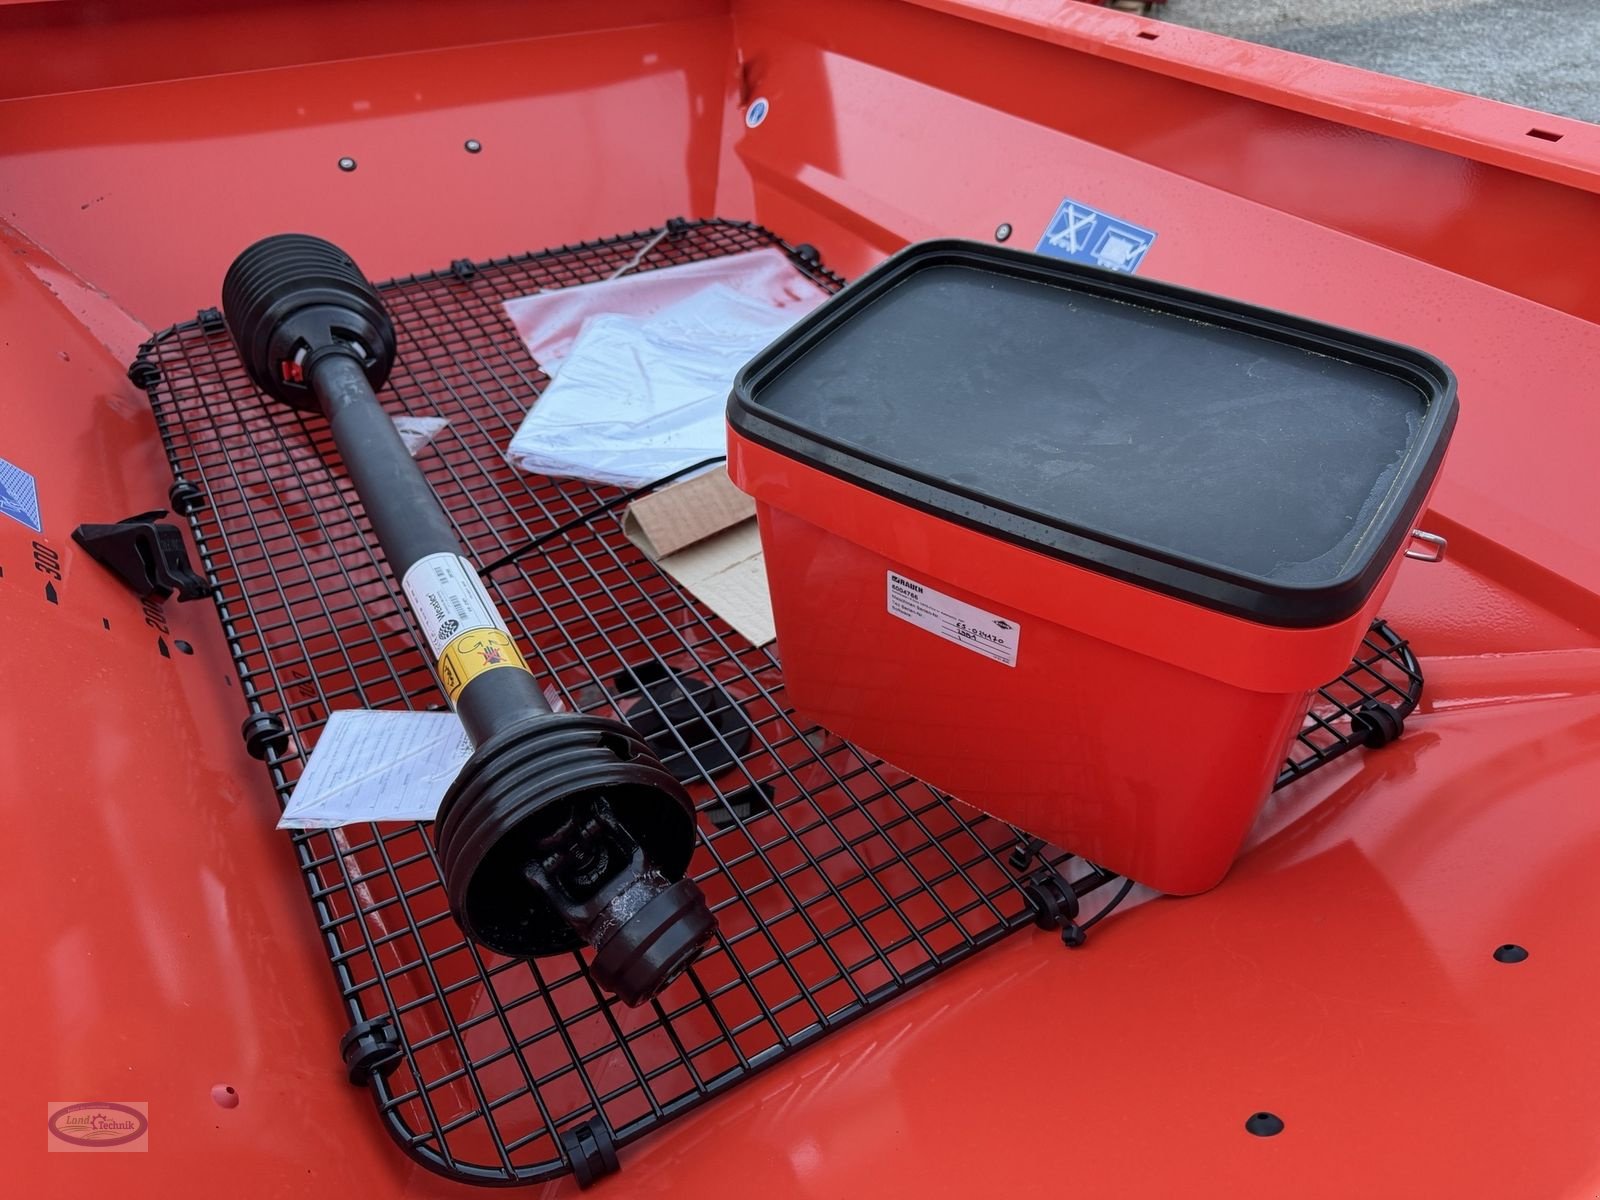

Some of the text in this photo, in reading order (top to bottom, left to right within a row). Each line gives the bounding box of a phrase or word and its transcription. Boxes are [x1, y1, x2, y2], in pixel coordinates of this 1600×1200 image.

[32, 541, 62, 581] 300
[900, 579, 924, 594] RAUCH
[427, 594, 446, 622] Weasler
